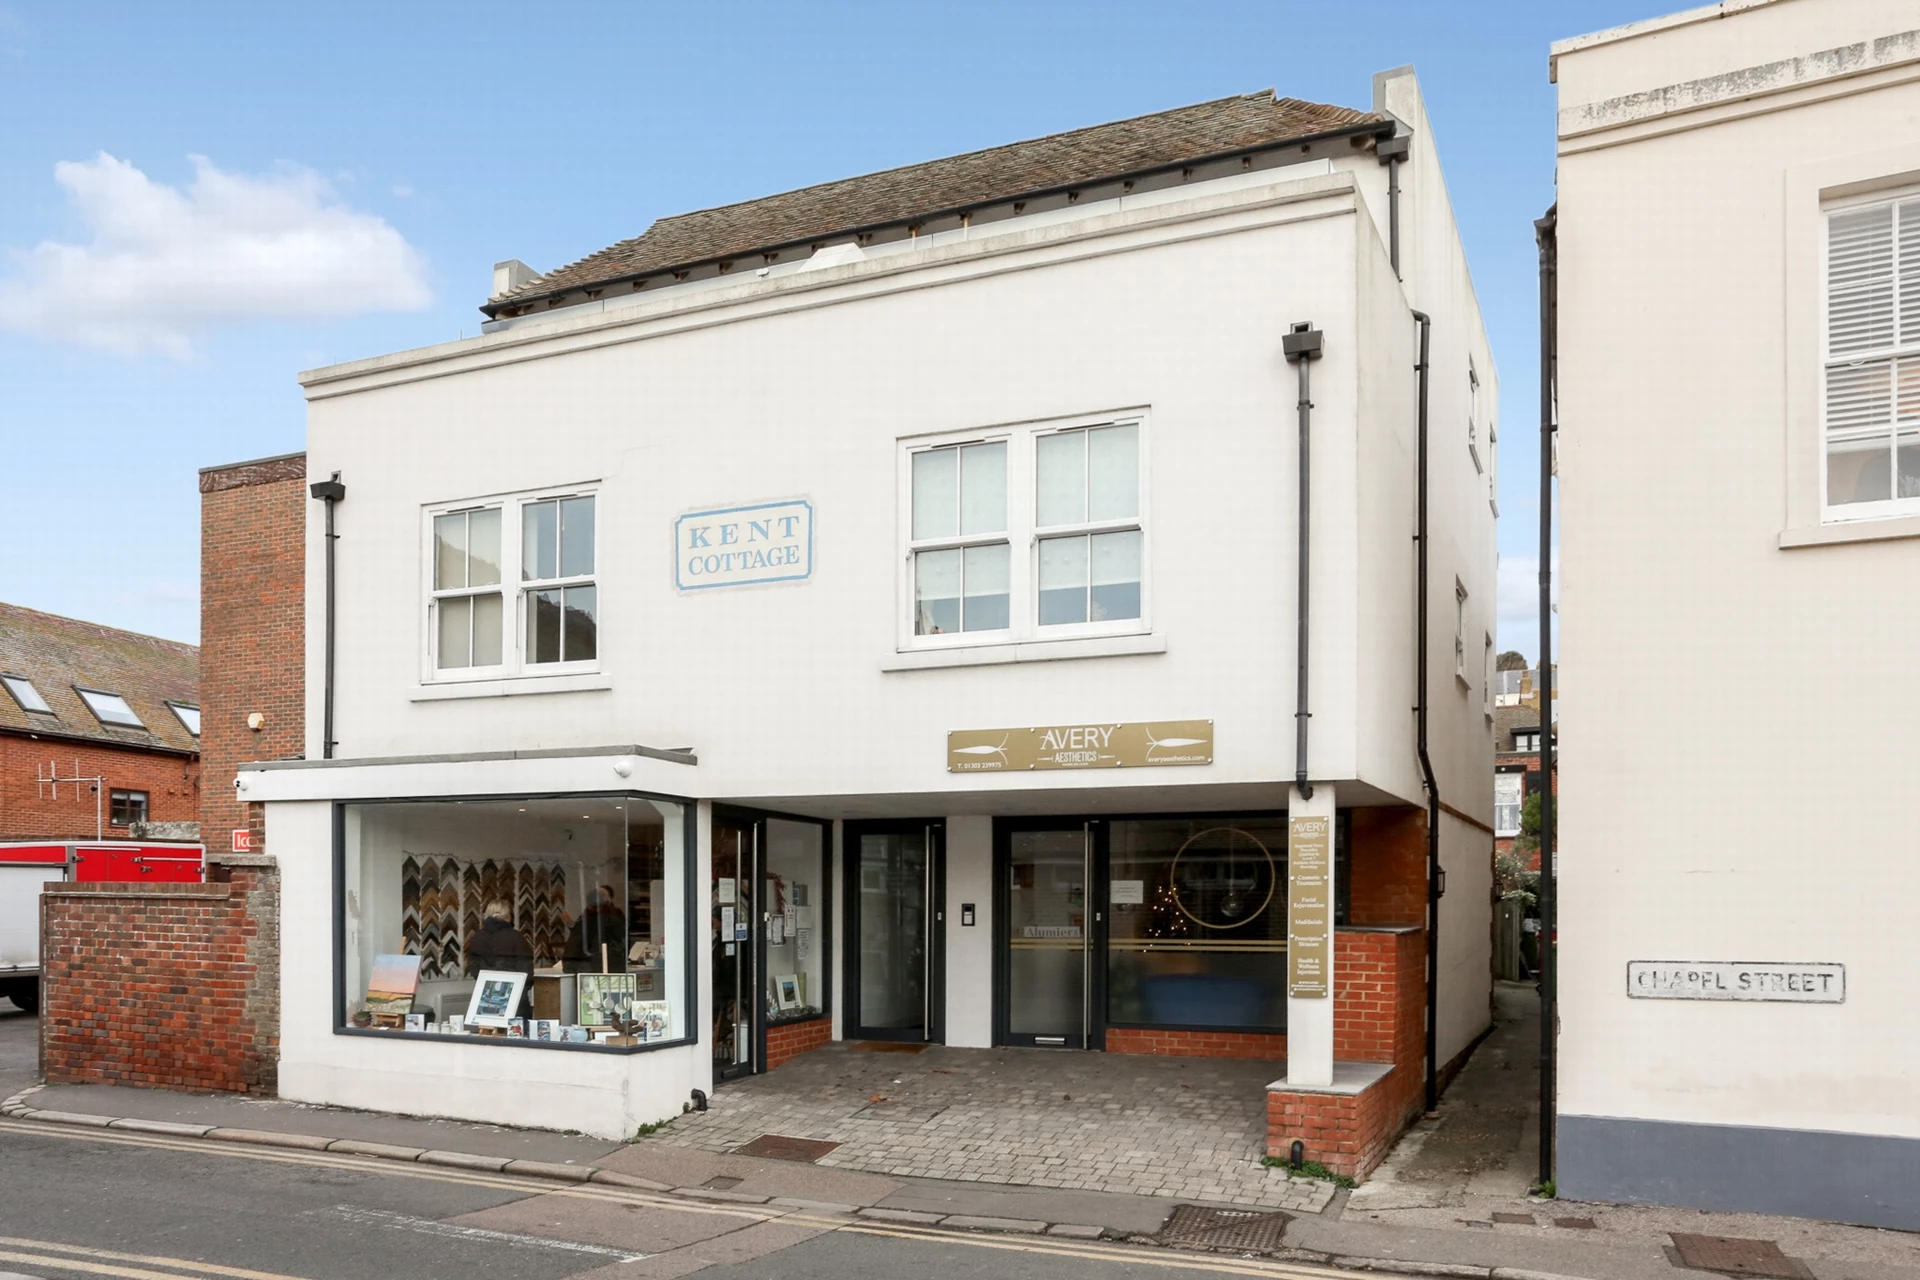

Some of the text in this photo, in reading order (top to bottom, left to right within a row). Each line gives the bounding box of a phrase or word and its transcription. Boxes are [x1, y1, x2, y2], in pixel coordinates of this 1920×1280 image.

[689, 516, 800, 549] KENT
[688, 545, 800, 576] COTTAGE
[1041, 727, 1114, 750] AVERY
[1055, 751, 1097, 763] AESTHETICS
[1293, 822, 1327, 833] AVERY
[1638, 970, 1834, 992] CHAPEL STREET
